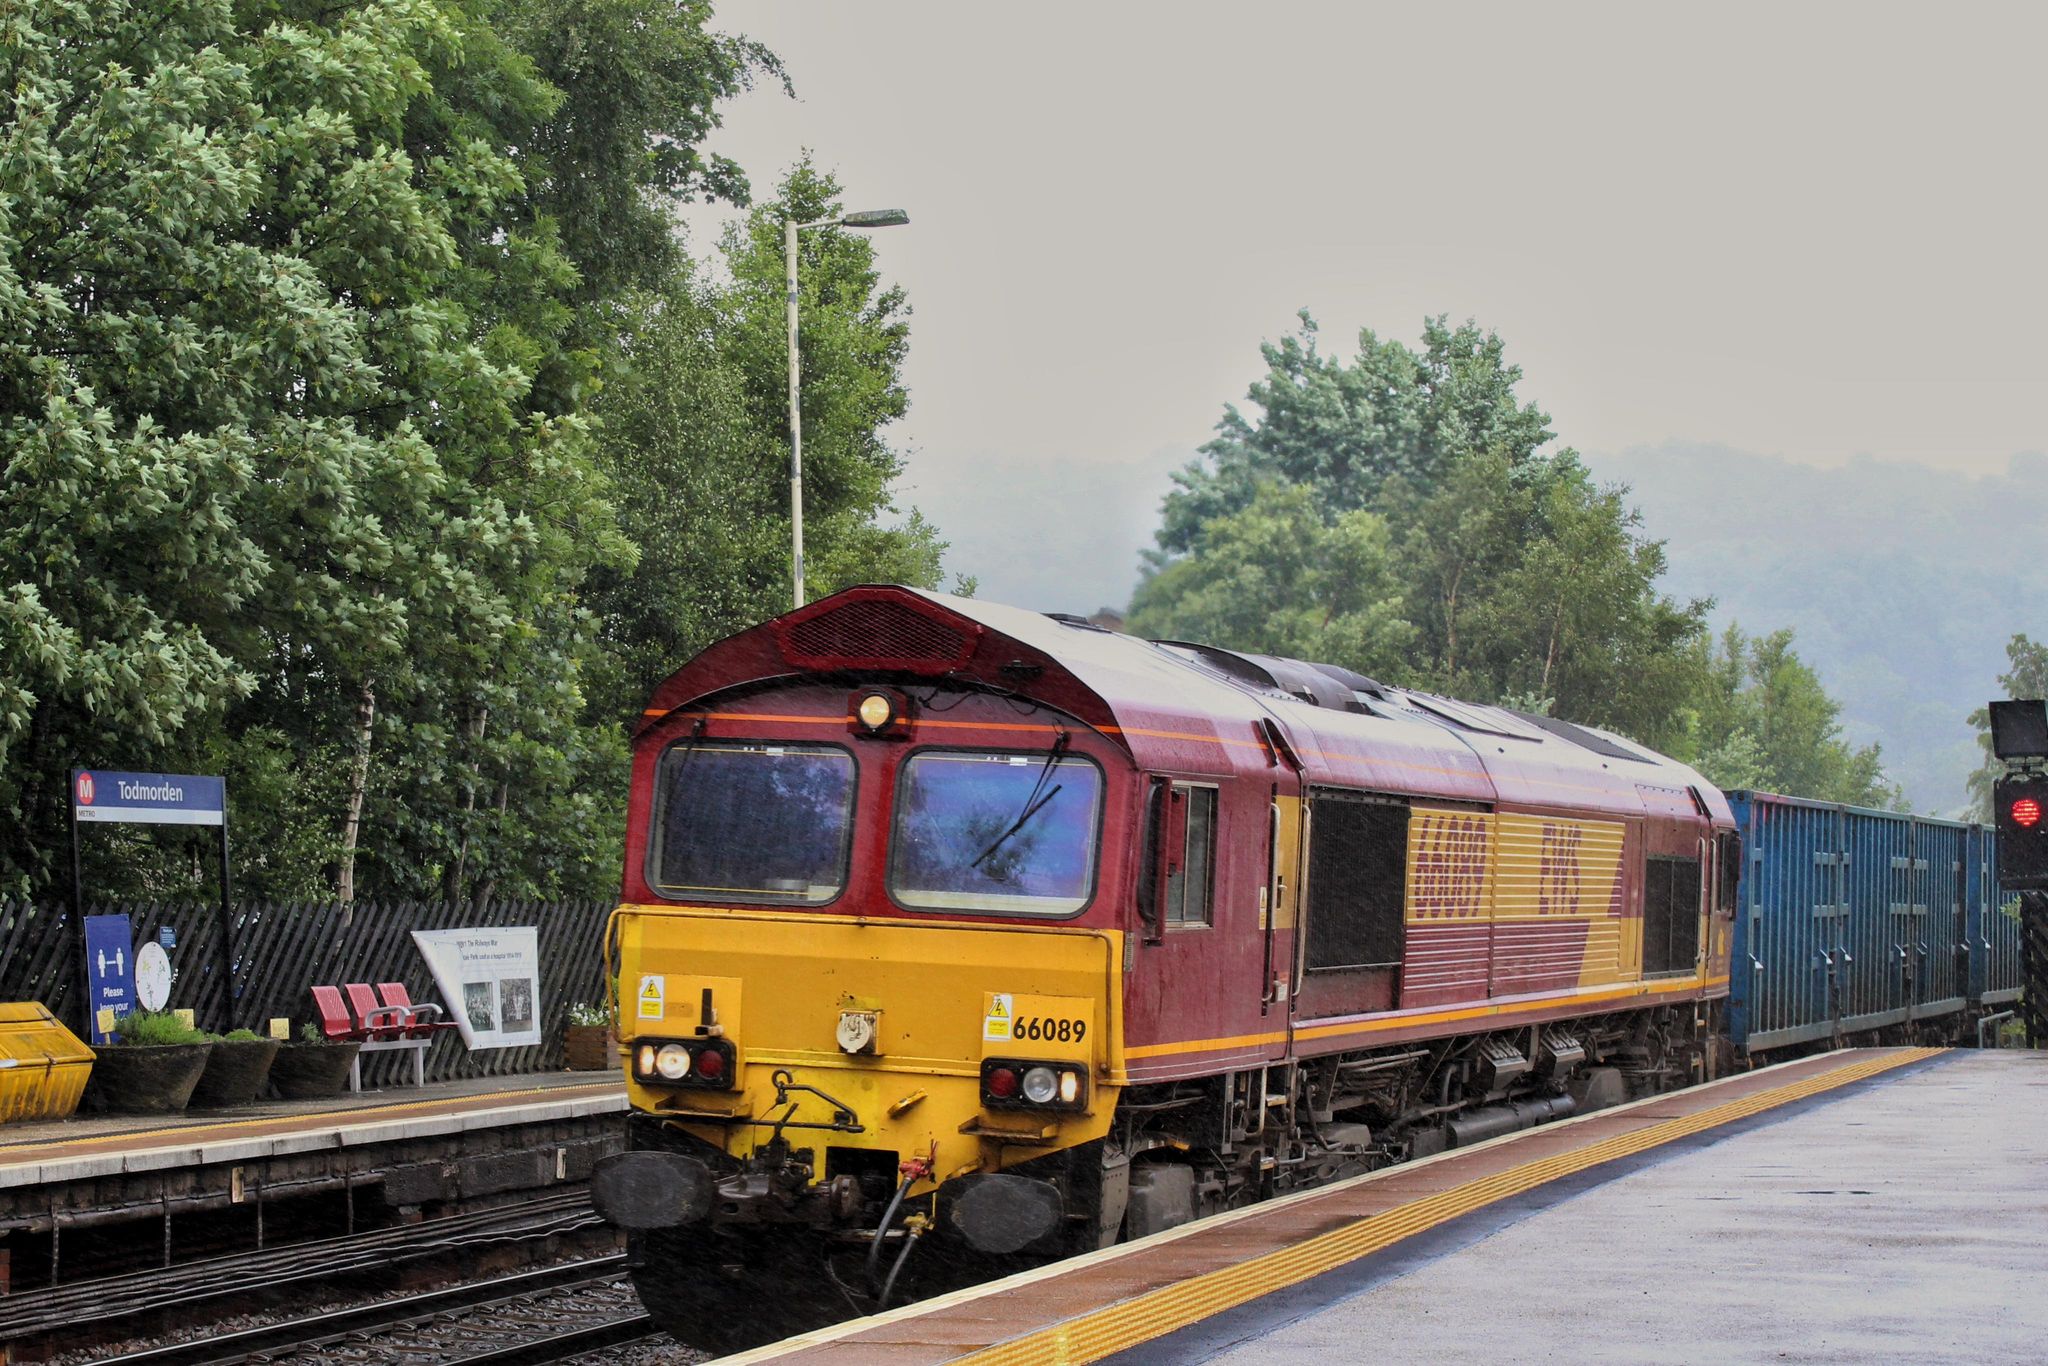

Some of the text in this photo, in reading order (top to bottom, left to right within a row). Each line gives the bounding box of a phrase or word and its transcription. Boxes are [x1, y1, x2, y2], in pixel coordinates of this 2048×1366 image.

[79, 779, 93, 799] M
[118, 780, 184, 802] Todmorden
[78, 810, 96, 818] METRO
[1414, 814, 1487, 918] 66089
[103, 986, 124, 998] Please
[114, 1002, 129, 1014] your
[1013, 1016, 1087, 1043] 66089
